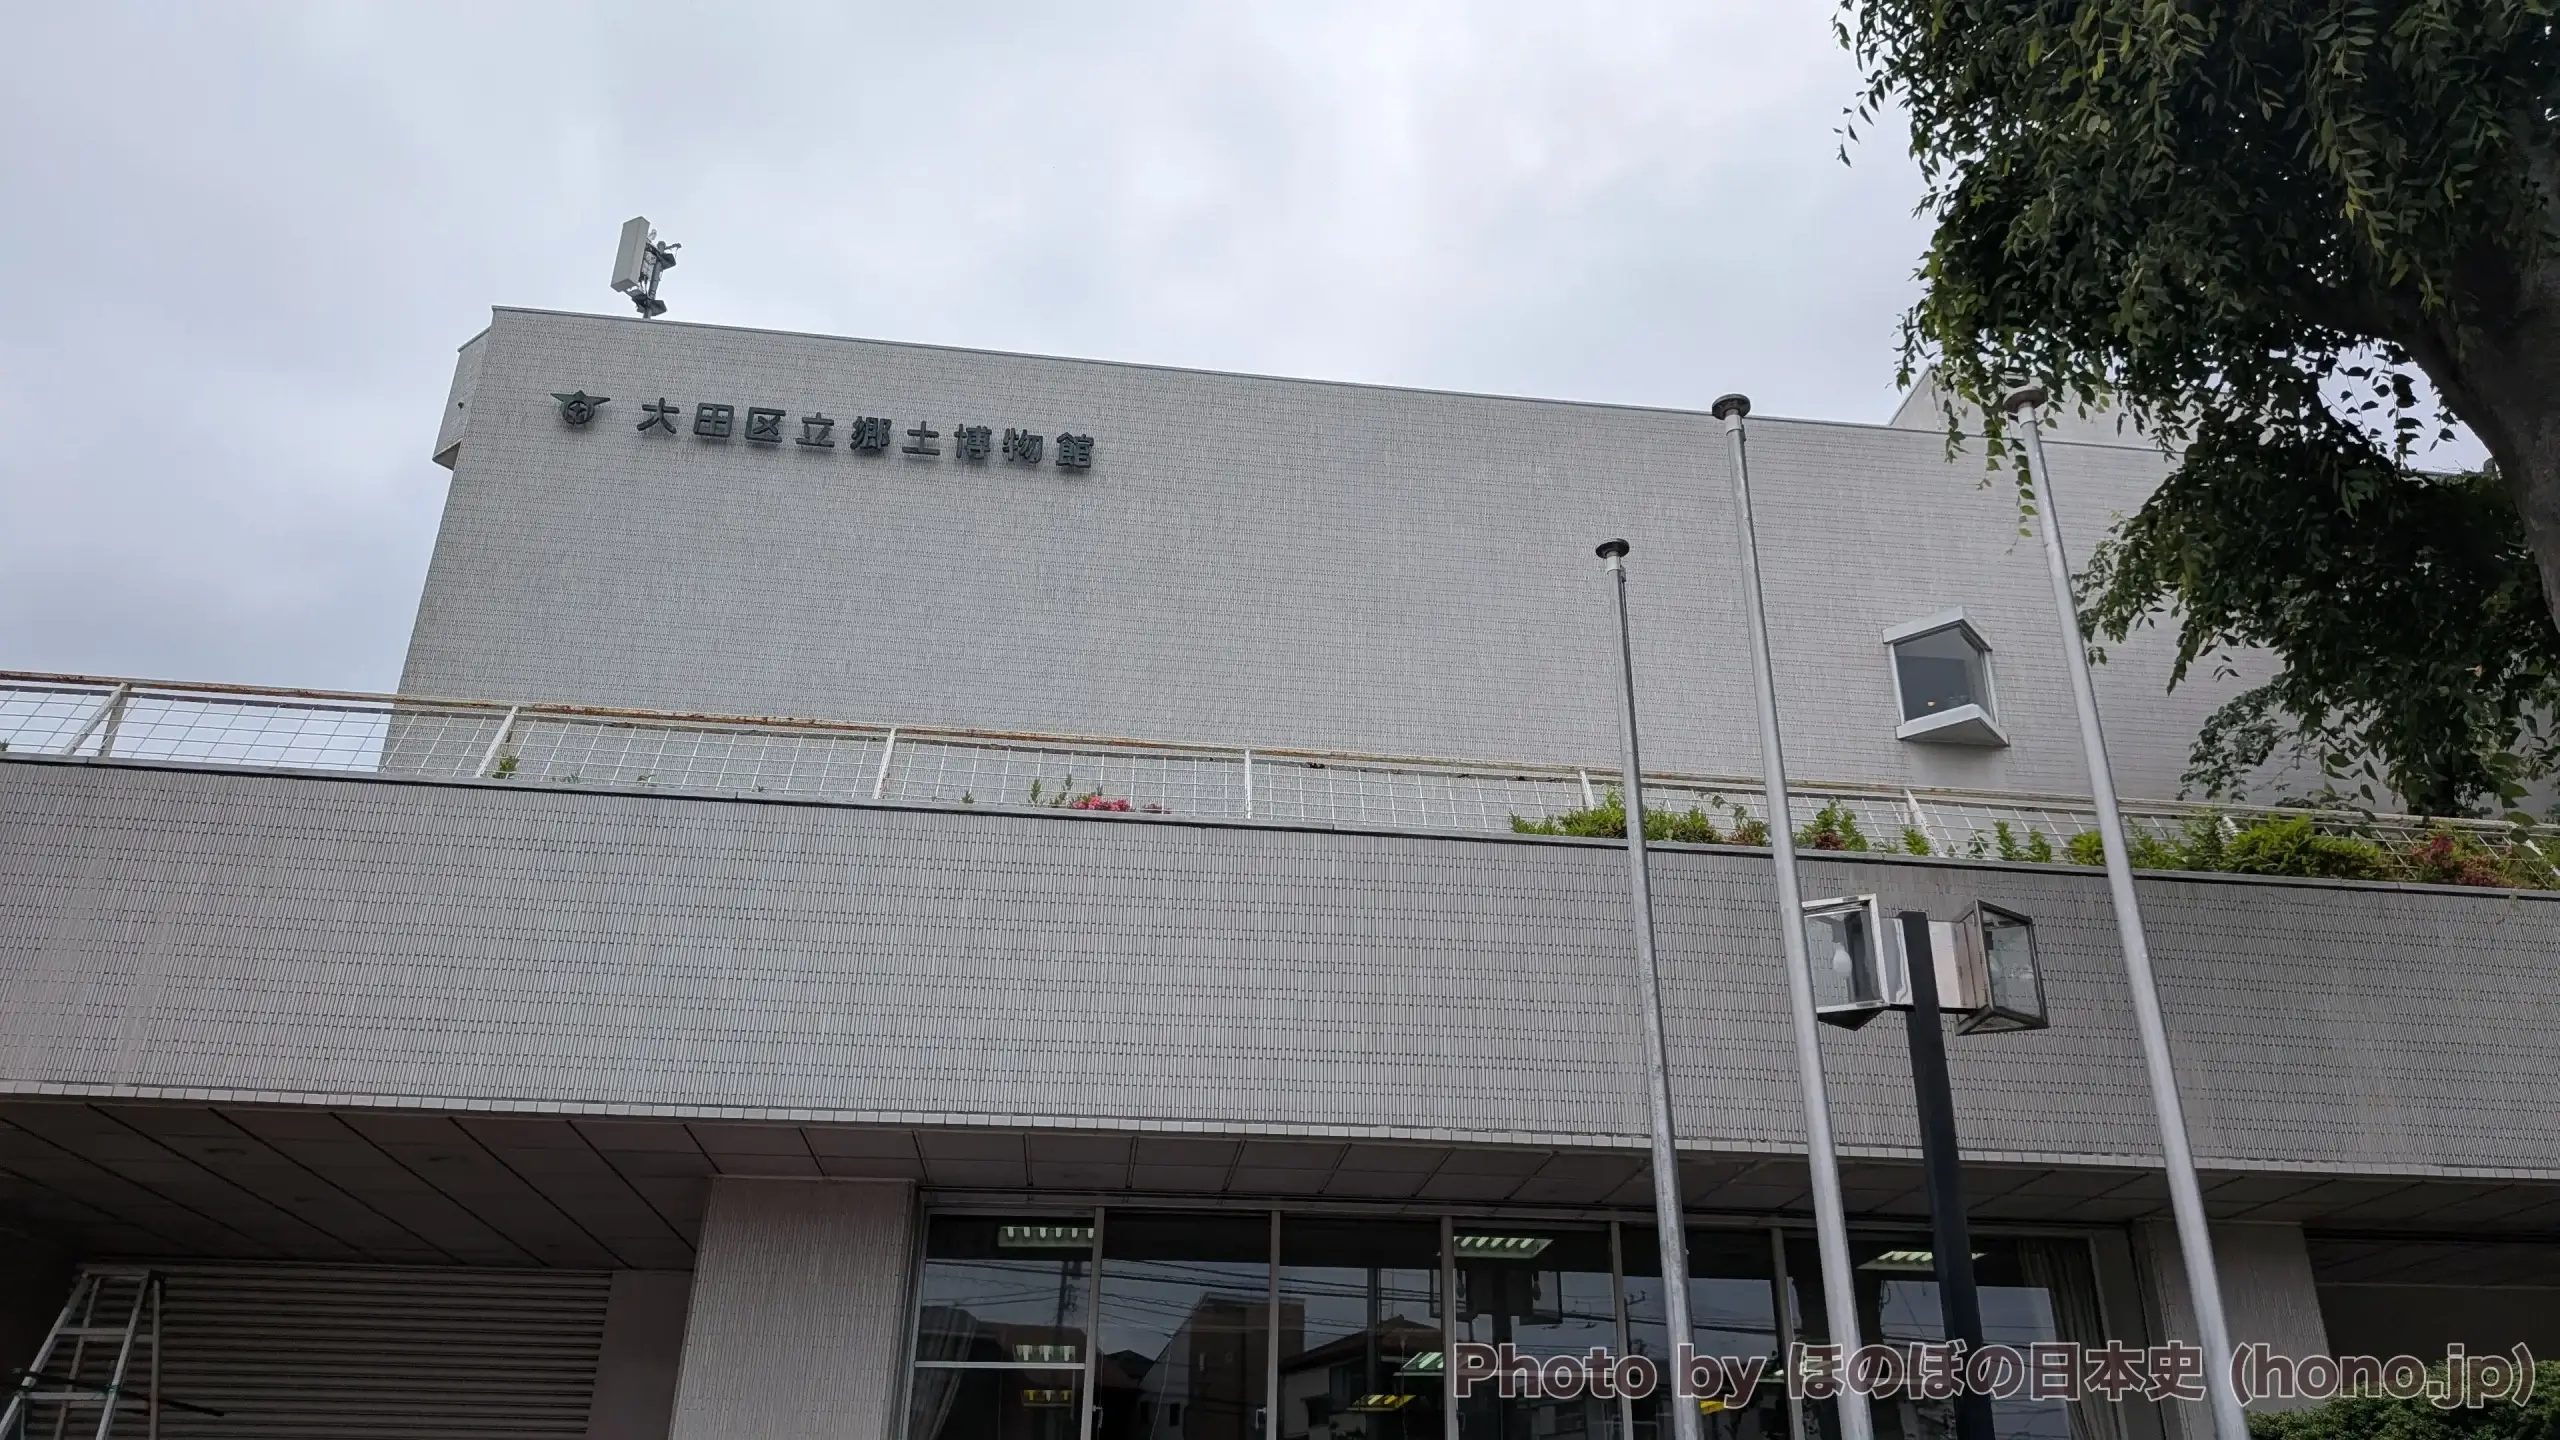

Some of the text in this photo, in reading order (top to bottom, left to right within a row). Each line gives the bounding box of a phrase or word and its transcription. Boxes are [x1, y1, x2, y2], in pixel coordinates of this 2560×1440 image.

[637, 397, 1095, 468] 大田区立郷土博物館
